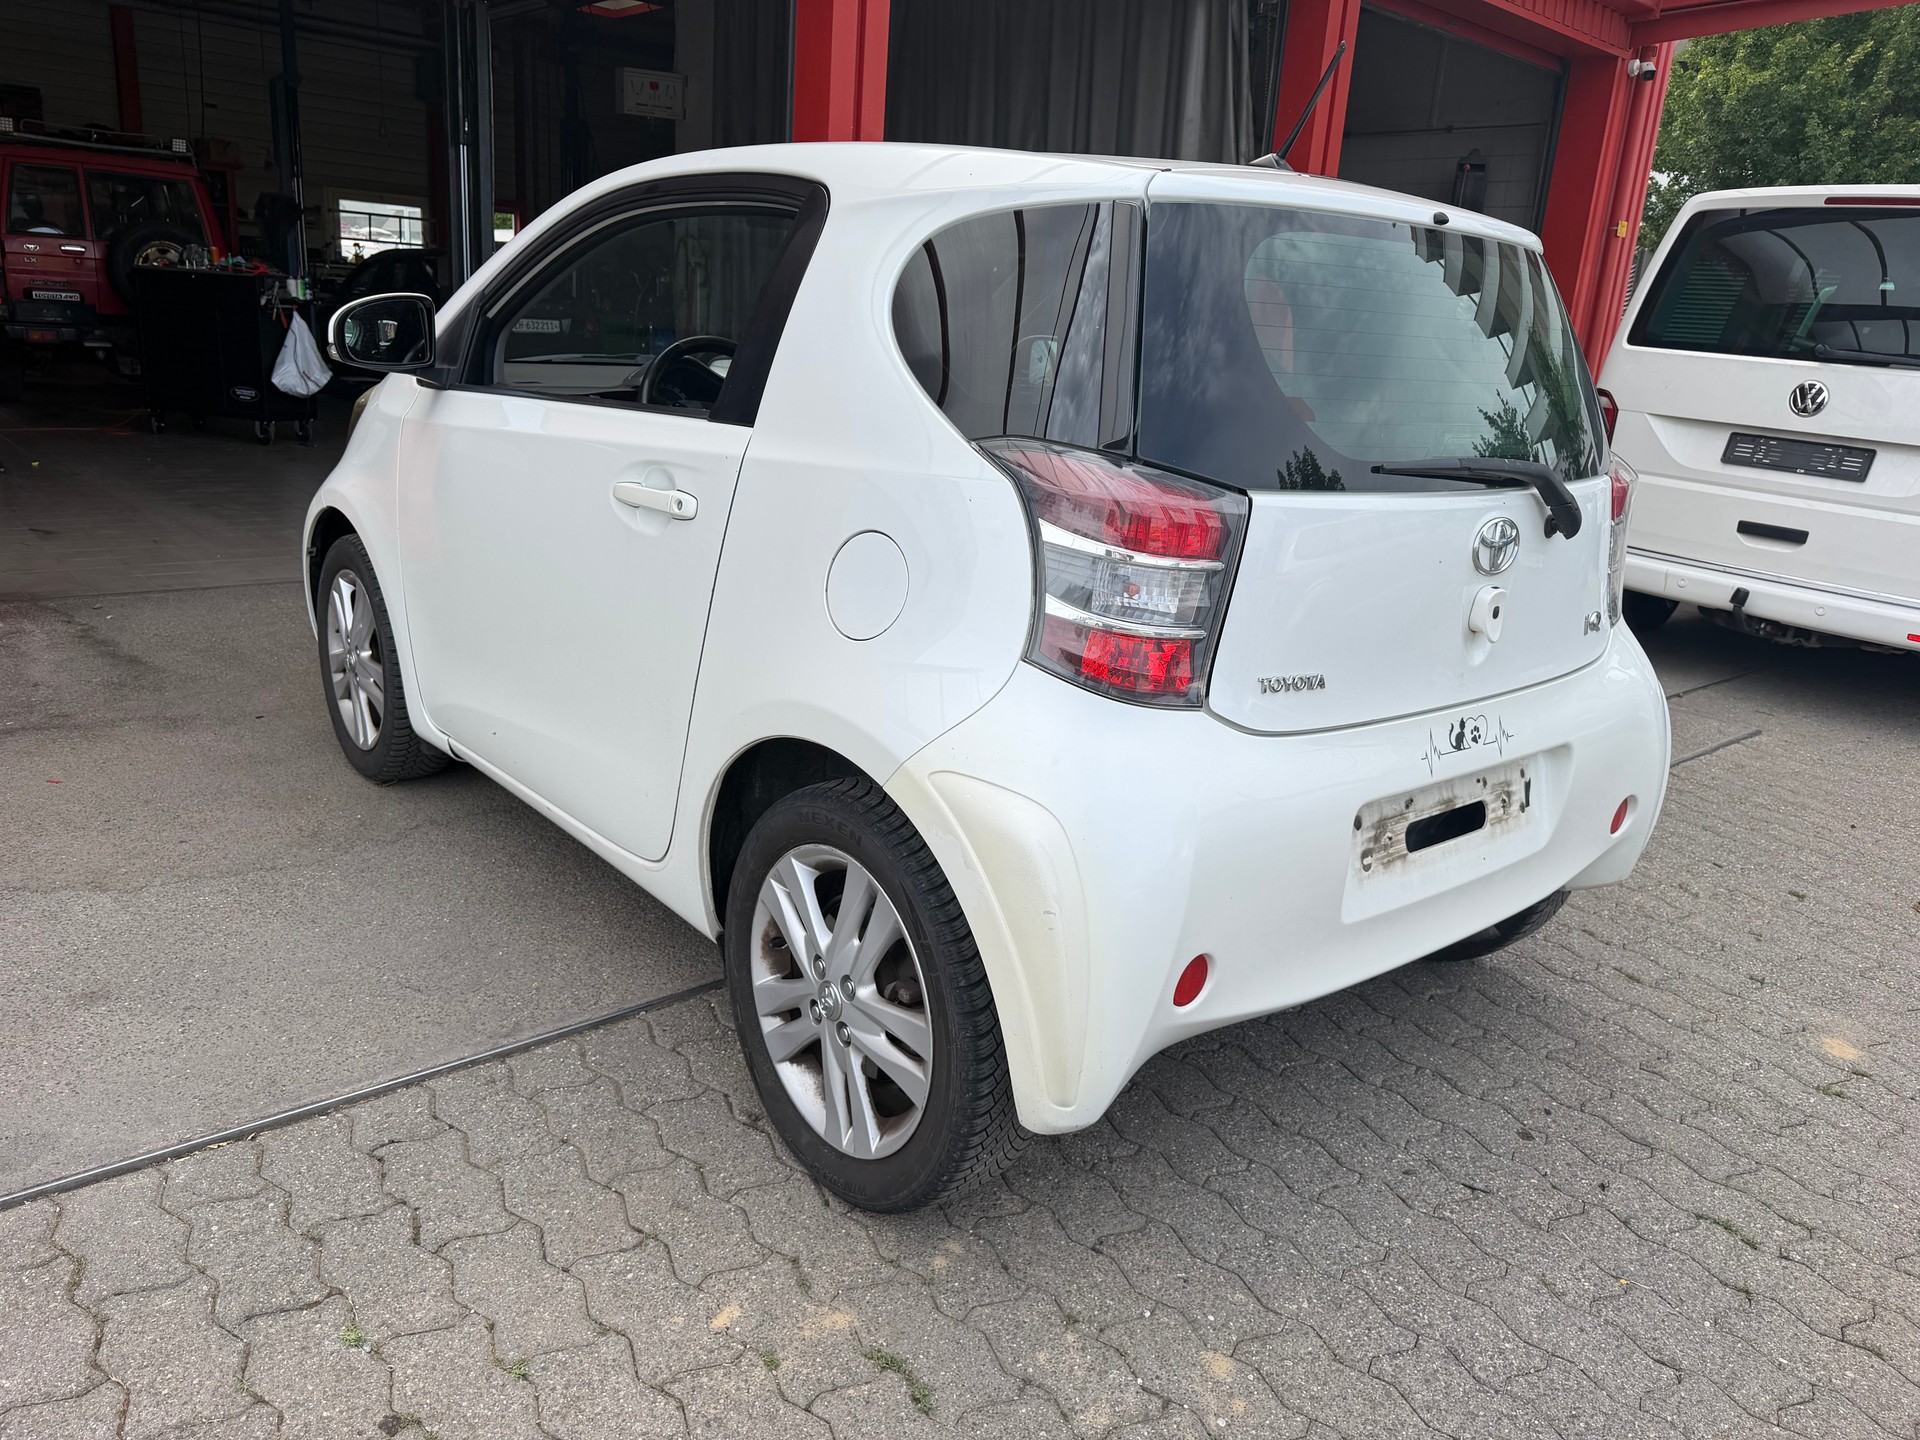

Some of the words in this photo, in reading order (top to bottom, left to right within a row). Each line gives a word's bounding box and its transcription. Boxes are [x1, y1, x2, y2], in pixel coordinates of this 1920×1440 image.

[34, 292, 62, 300] TOYOTA
[1258, 674, 1326, 694] TOYOTA
[799, 811, 863, 848] NEXEN
